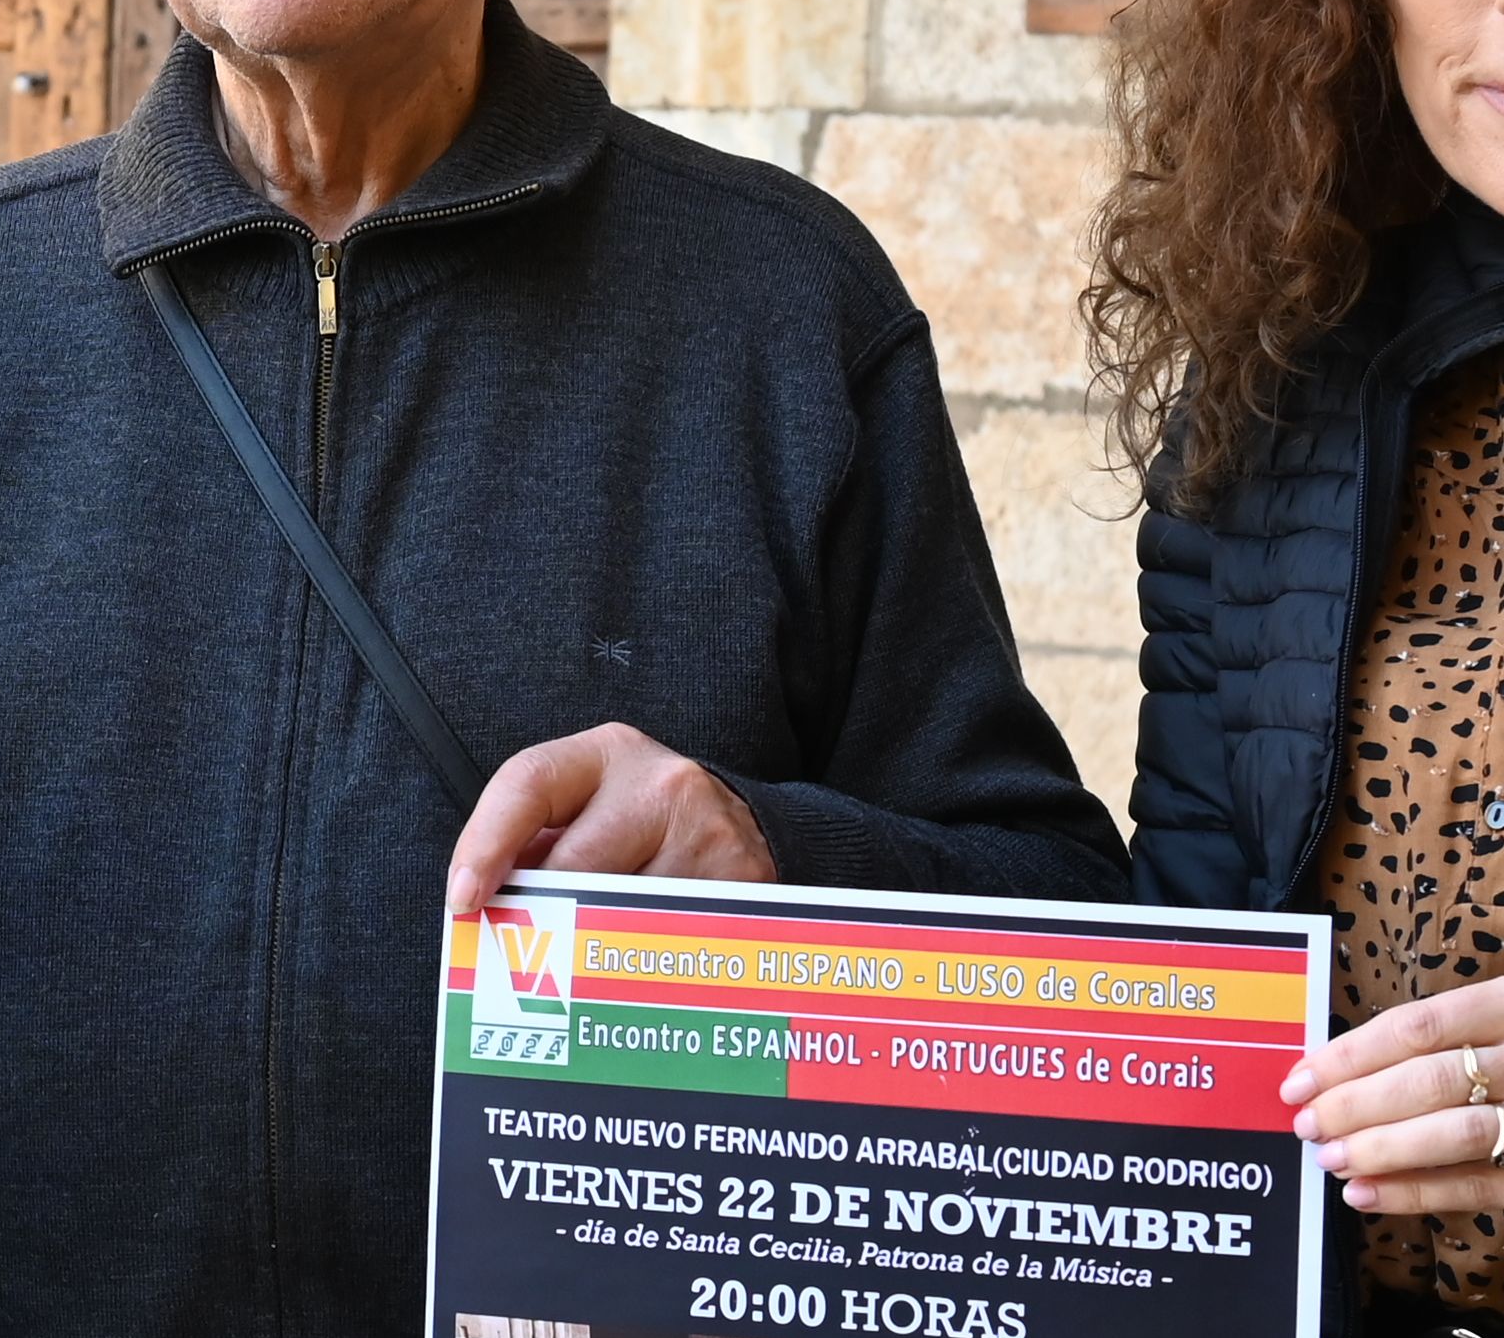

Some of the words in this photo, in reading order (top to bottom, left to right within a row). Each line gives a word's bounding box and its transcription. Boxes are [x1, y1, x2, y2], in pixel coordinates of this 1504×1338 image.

[585, 939, 747, 980] Encuentro
[758, 951, 902, 990] HISPANO
[938, 962, 1025, 998] LUSO
[1037, 967, 1075, 1001] de
[1089, 972, 1214, 1010] Corales
[473, 1031, 567, 1060] 2024
[578, 1015, 701, 1054] Encontro
[712, 1025, 861, 1065] ESPANHOL
[891, 1037, 1065, 1081] PORTUGUES
[1076, 1047, 1110, 1082] de
[1121, 1052, 1214, 1090] Corais
[484, 1108, 586, 1141] TEATRO
[595, 1117, 685, 1148] NUEVO
[695, 1124, 848, 1161] FERNANDO
[1124, 1156, 1272, 1197] RODRIGO)
[488, 1158, 703, 1214] VIERNES
[719, 1177, 774, 1220] 22
[790, 1183, 869, 1227] DE
[884, 1190, 1251, 1256] NOVIEMBRE
[574, 1219, 615, 1244] día
[624, 1224, 659, 1248] de
[666, 1227, 739, 1254] Santa
[749, 1234, 851, 1267] Cecilia,
[858, 1242, 963, 1272] Patrona
[973, 1252, 1009, 1276] de
[1017, 1254, 1042, 1278] la
[1051, 1257, 1152, 1287] Música
[690, 1278, 825, 1326] 20:00
